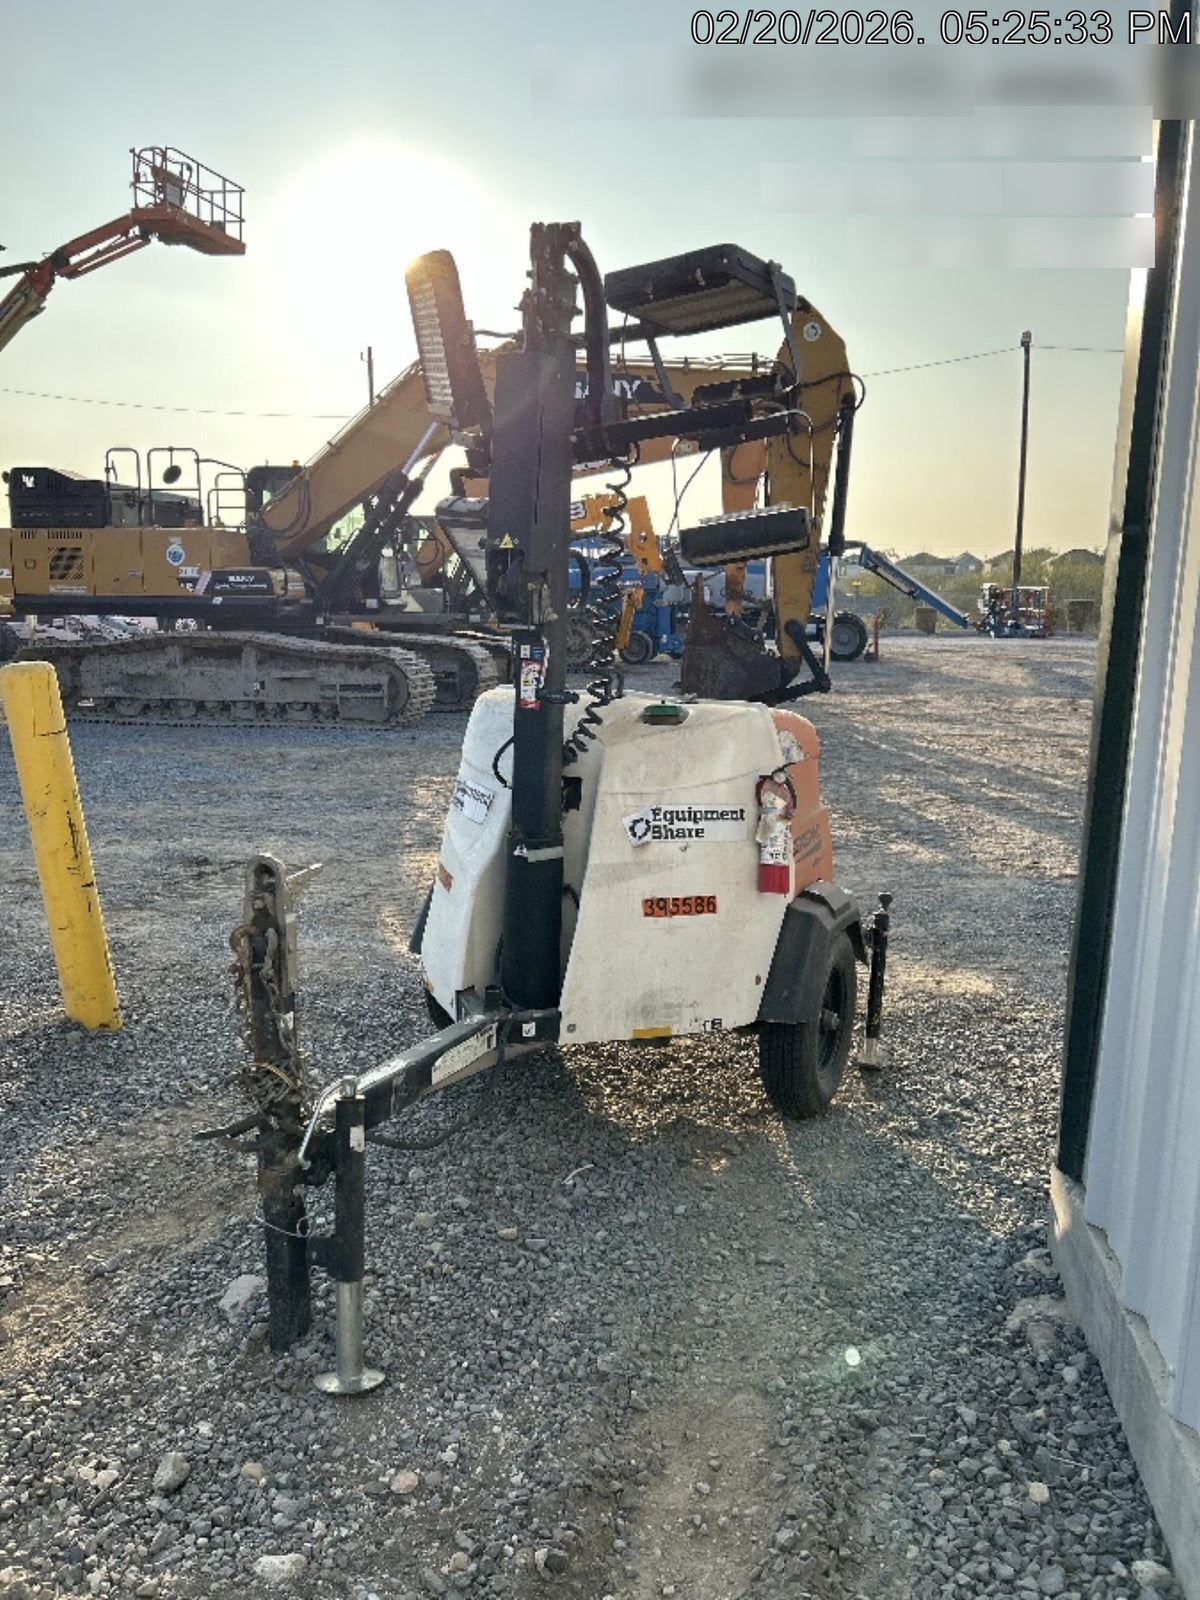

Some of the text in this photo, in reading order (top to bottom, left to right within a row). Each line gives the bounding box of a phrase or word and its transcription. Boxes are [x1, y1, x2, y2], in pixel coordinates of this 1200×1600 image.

[650, 806, 746, 825] Equipment
[651, 824, 705, 839] Share
[643, 895, 717, 917] 395586
